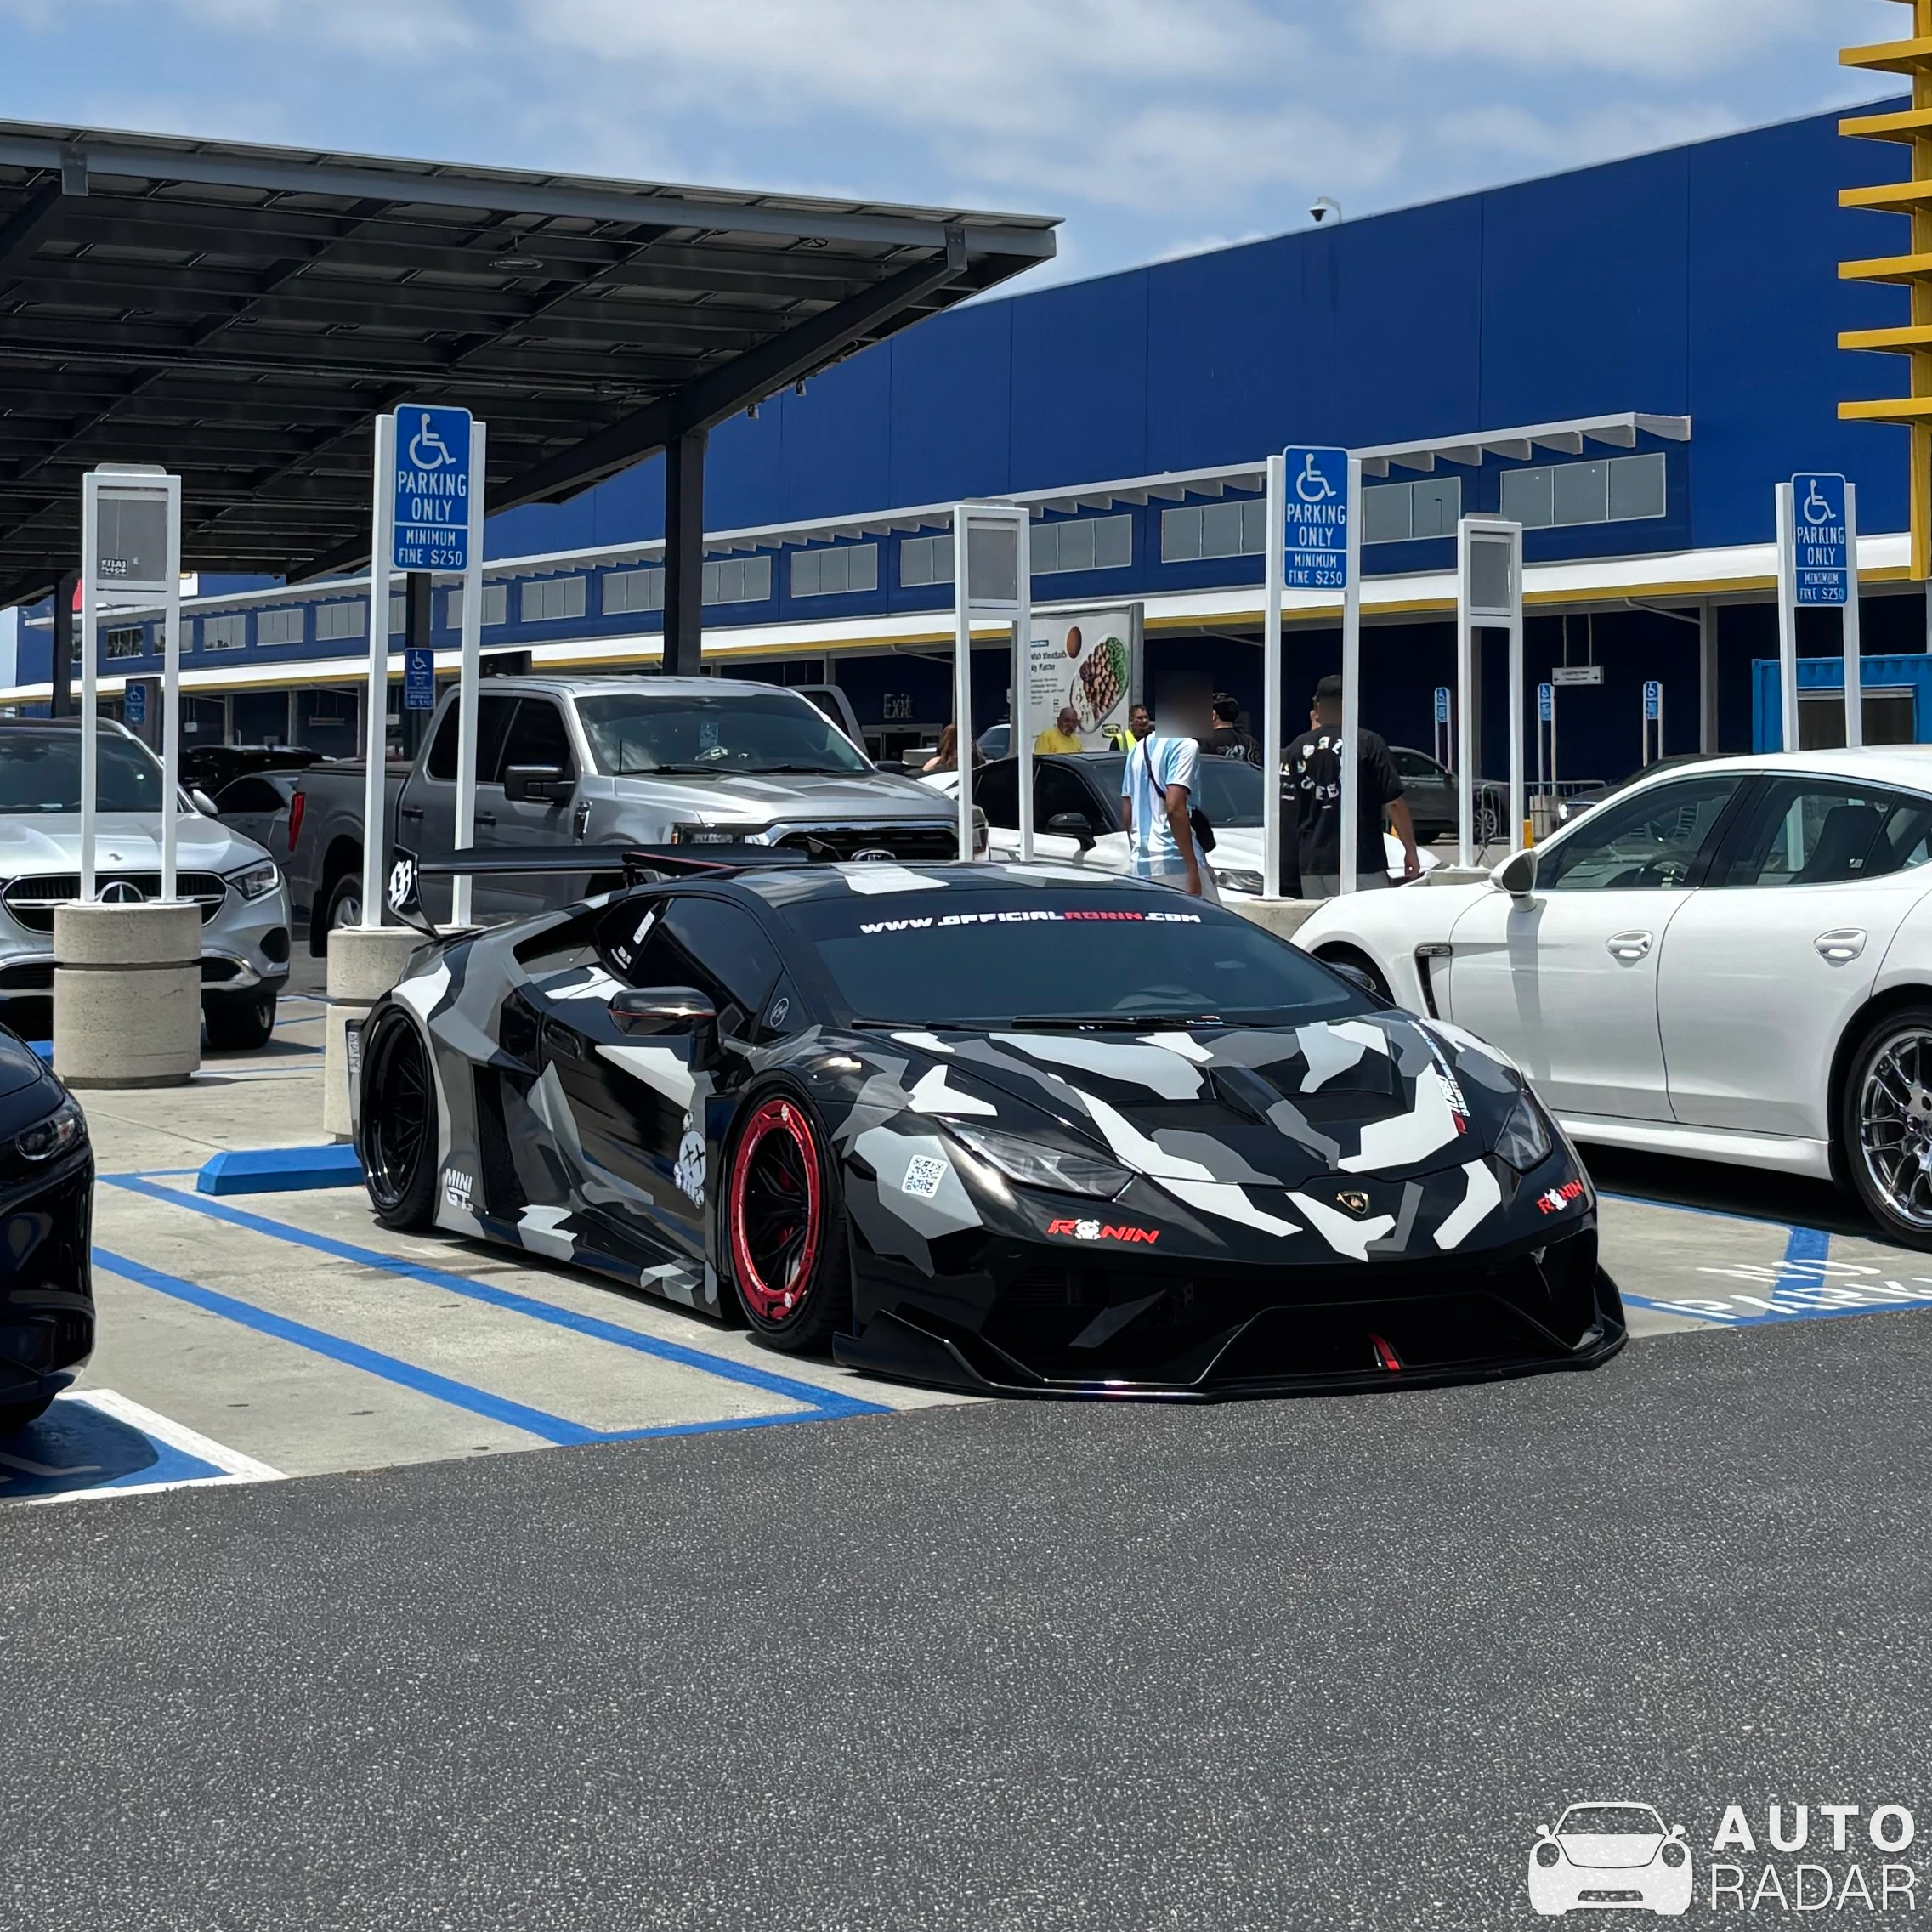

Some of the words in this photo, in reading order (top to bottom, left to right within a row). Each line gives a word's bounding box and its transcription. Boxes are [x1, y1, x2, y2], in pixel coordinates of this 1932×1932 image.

[398, 471, 467, 497] PARKING
[411, 497, 453, 522] ONLY
[1287, 503, 1346, 524] PARKING
[406, 529, 456, 547] MINIMUM
[1298, 526, 1334, 547] ONLY
[1797, 526, 1845, 545] PARKING
[398, 547, 423, 564] FINE
[430, 549, 463, 566] $250
[1294, 552, 1337, 569] MINIMUM
[1807, 547, 1836, 566] ONLY
[1288, 569, 1310, 584] FINE
[1315, 570, 1343, 585] $250
[1822, 587, 1845, 600] $250
[443, 1168, 473, 1193] MINI
[1696, 1259, 1882, 1283] NO
